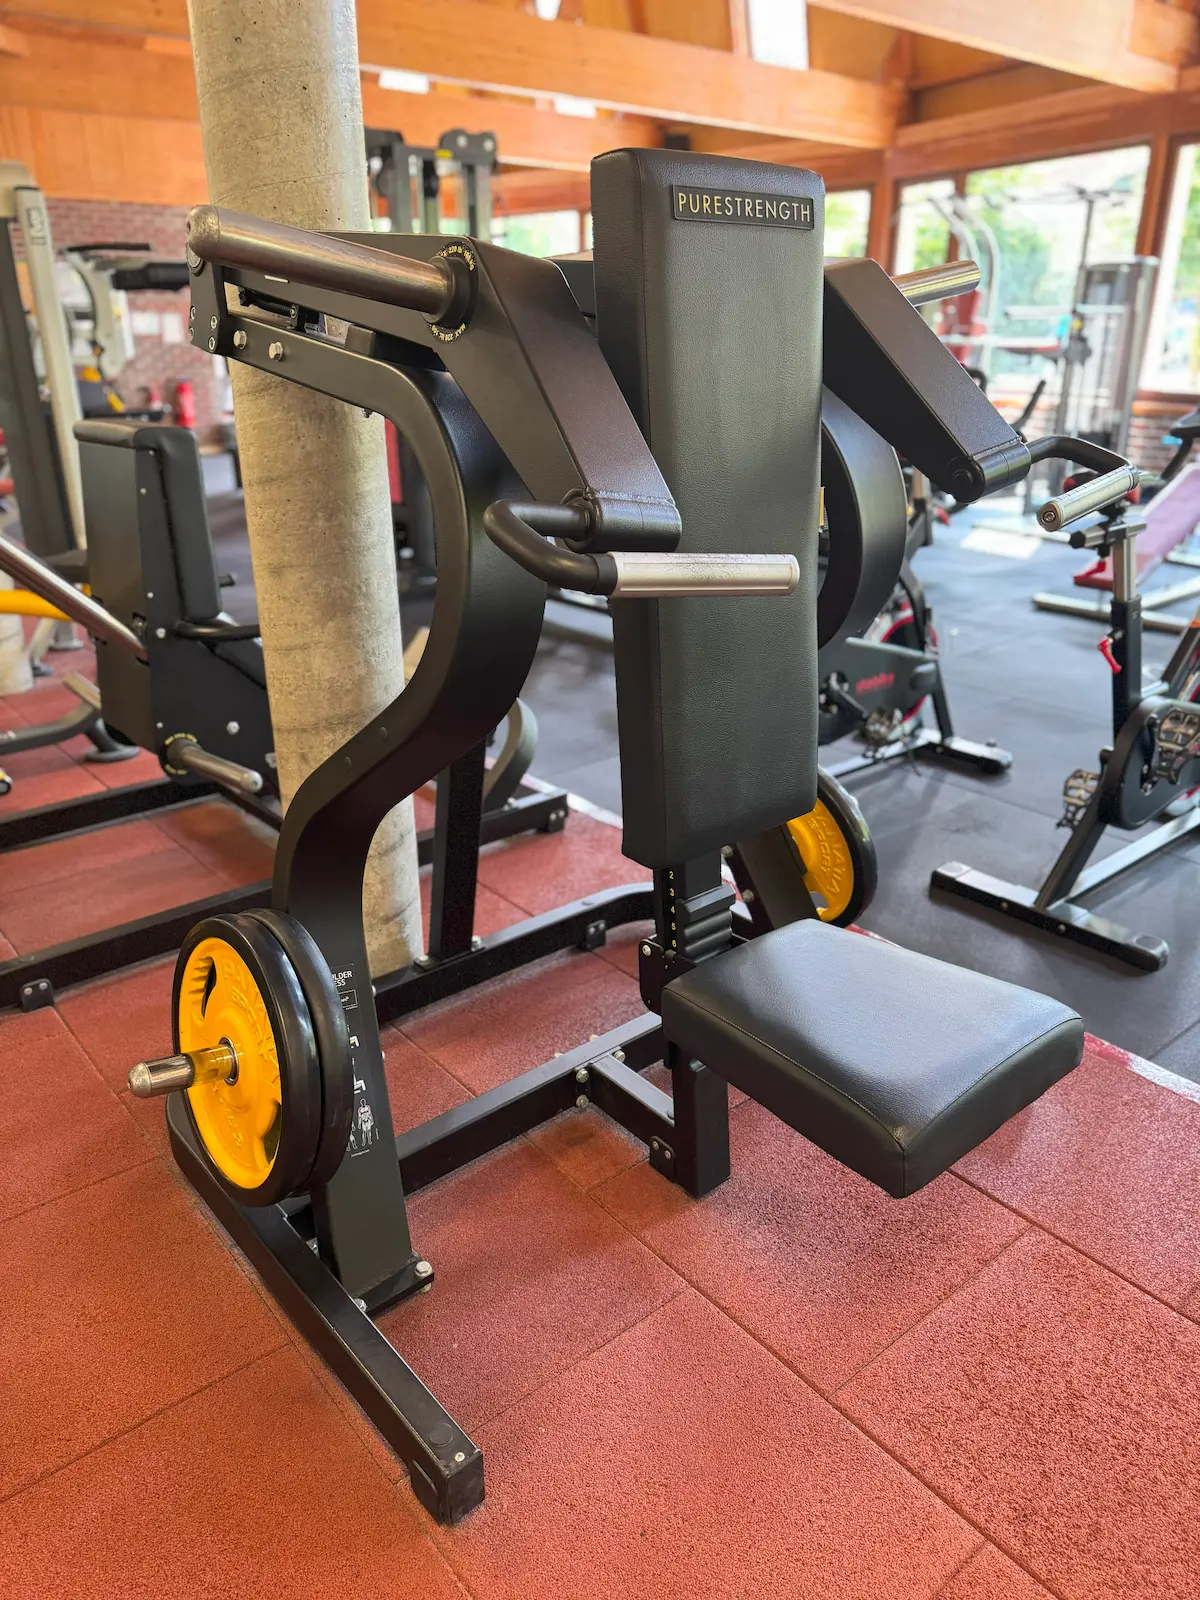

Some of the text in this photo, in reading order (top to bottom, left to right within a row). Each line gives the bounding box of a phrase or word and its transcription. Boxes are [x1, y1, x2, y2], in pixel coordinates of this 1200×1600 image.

[678, 192, 810, 222] PURESTRENGTH
[669, 870, 675, 880] 2
[669, 887, 675, 897] 3
[670, 905, 676, 914] 4
[671, 922, 677, 931] 5
[671, 939, 678, 948] 6
